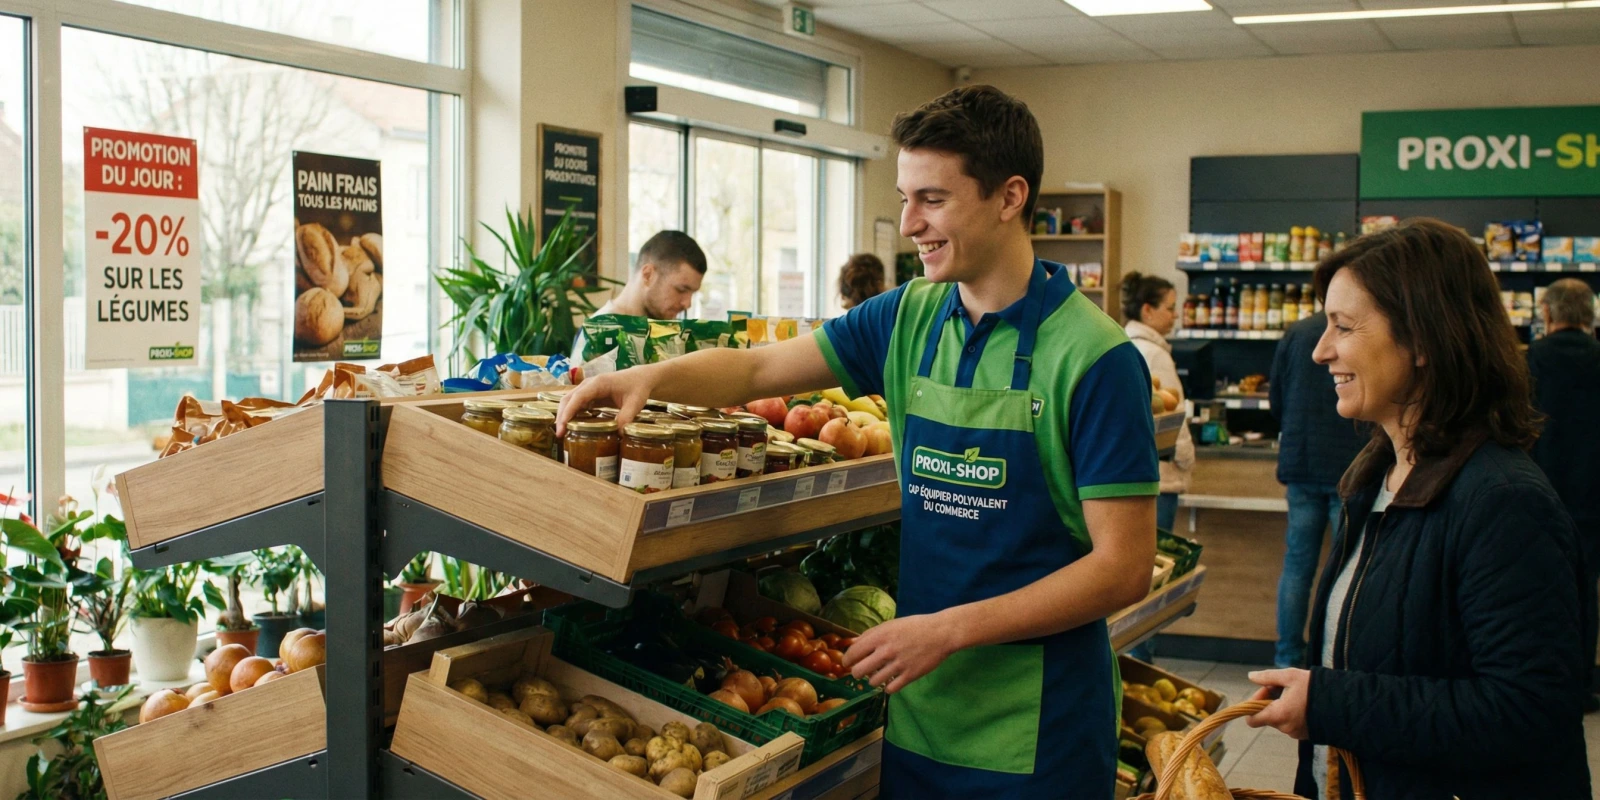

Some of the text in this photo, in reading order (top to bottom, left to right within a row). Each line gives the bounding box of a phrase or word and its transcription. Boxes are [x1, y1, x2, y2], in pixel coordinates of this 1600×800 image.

[91, 137, 191, 167] PROMOTION
[102, 164, 126, 186] DU
[130, 167, 174, 190] JOUR
[298, 169, 378, 197] PAIN FRAIS
[298, 194, 378, 212] TOUS LES MATINS
[96, 212, 189, 257] -20%
[104, 266, 183, 290] SUR LES
[98, 294, 189, 322] LÉGUMES
[915, 454, 1000, 481] PROXI-SHOP
[908, 484, 1008, 510] CAP ÉQUIPIER POLYVALENT
[923, 500, 980, 520] DU COMMERCE
